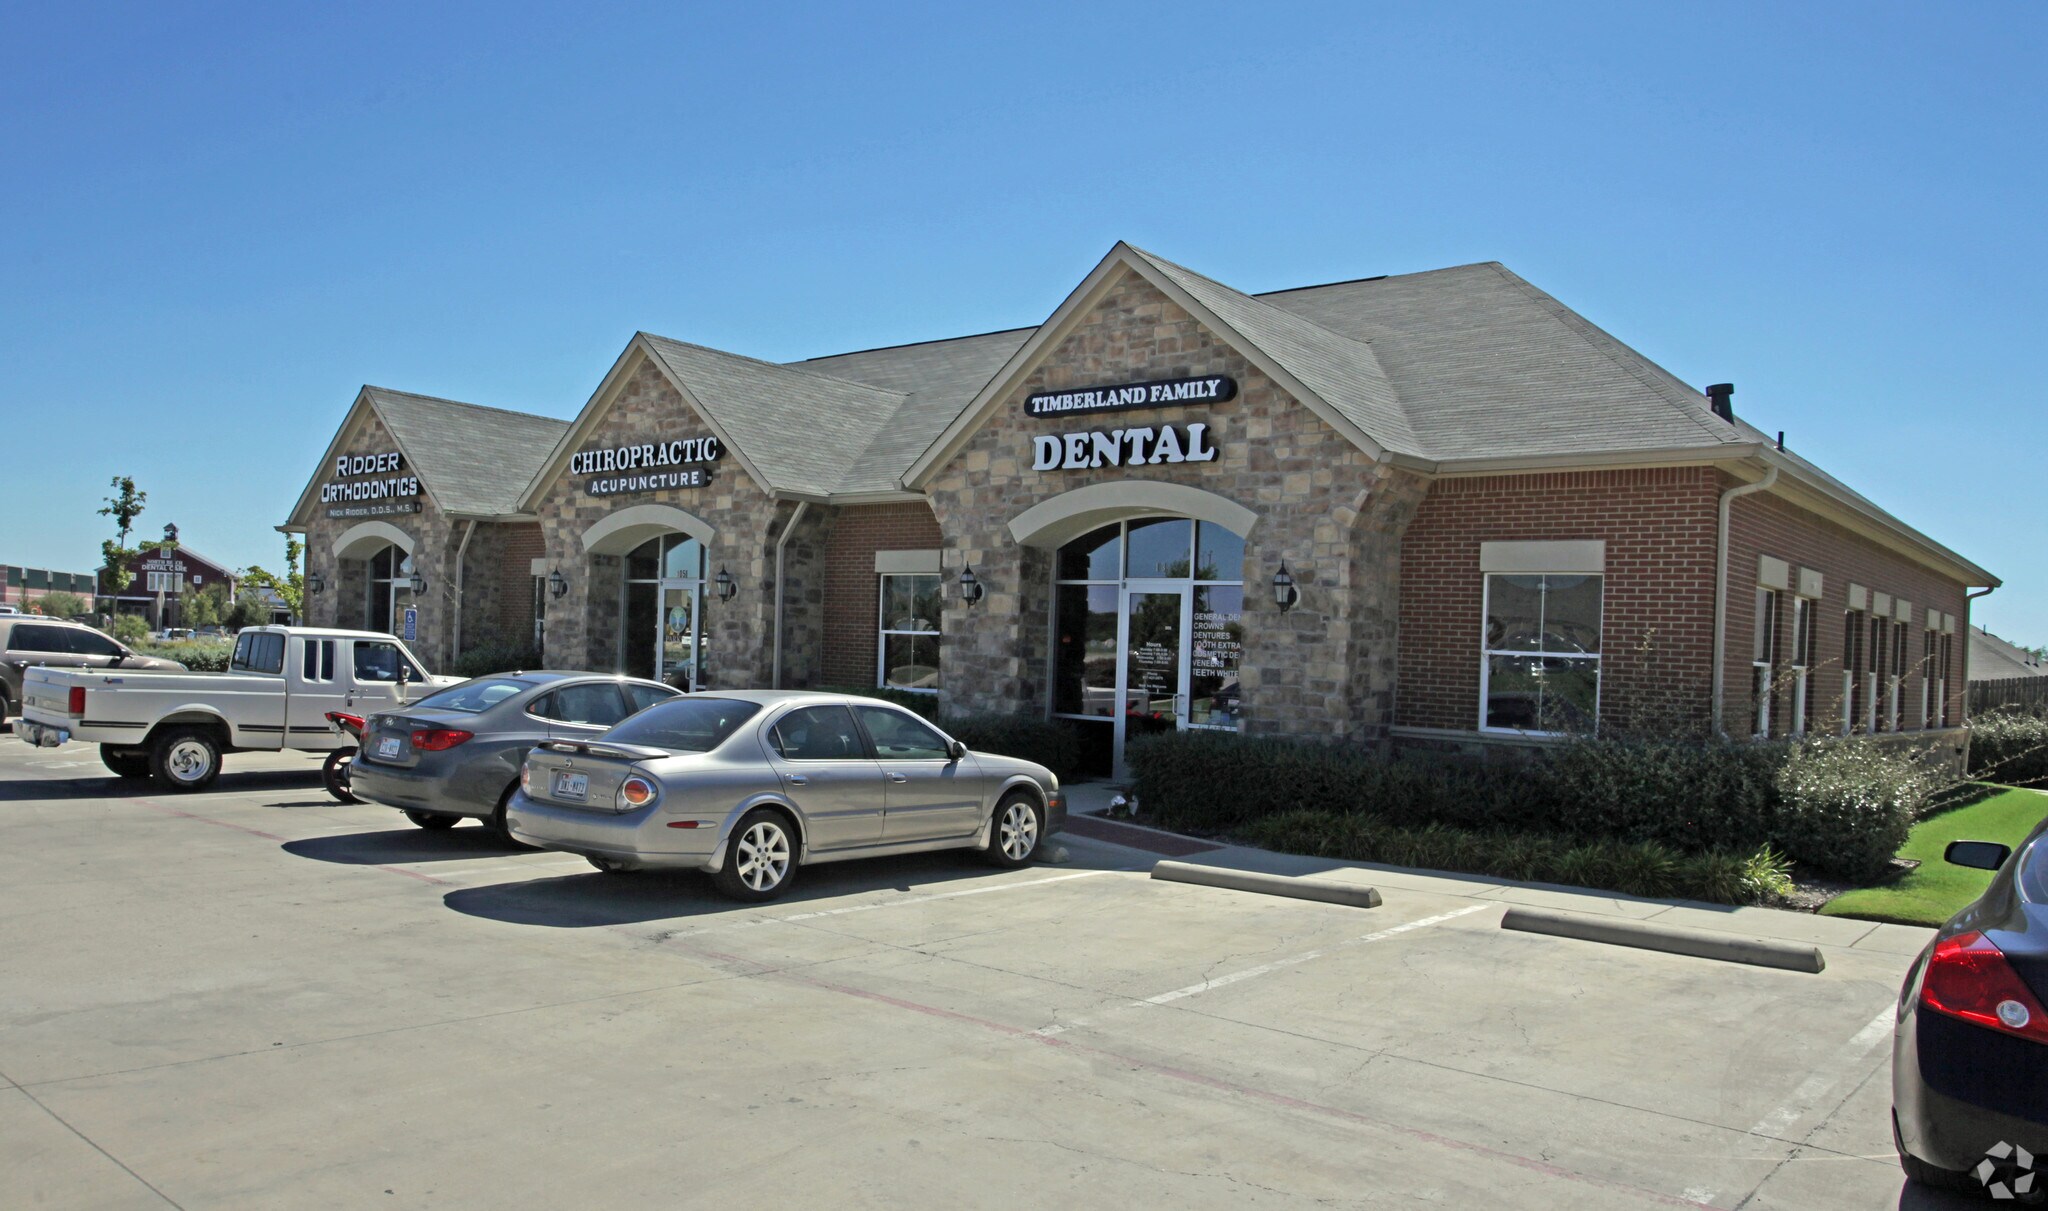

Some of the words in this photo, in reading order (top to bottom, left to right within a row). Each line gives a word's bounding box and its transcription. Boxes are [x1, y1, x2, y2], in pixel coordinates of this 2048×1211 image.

[1032, 386, 1147, 413] TIMBERLAND
[1150, 379, 1220, 402] FAMILY
[1032, 423, 1215, 471] DENTAL
[570, 436, 718, 475] CHIROPRACTIC
[336, 452, 400, 477] RIDDER
[321, 476, 418, 503] ORTHODONTICS
[591, 471, 700, 494] ACUPUNCTURE
[1194, 612, 1227, 621] GENERAL
[1193, 622, 1224, 630] CROWNS
[1193, 631, 1231, 640] DENTURES
[1192, 649, 1229, 659] COSMETIC
[1192, 659, 1224, 668] VENEERS
[1192, 668, 1216, 677] TEETH
